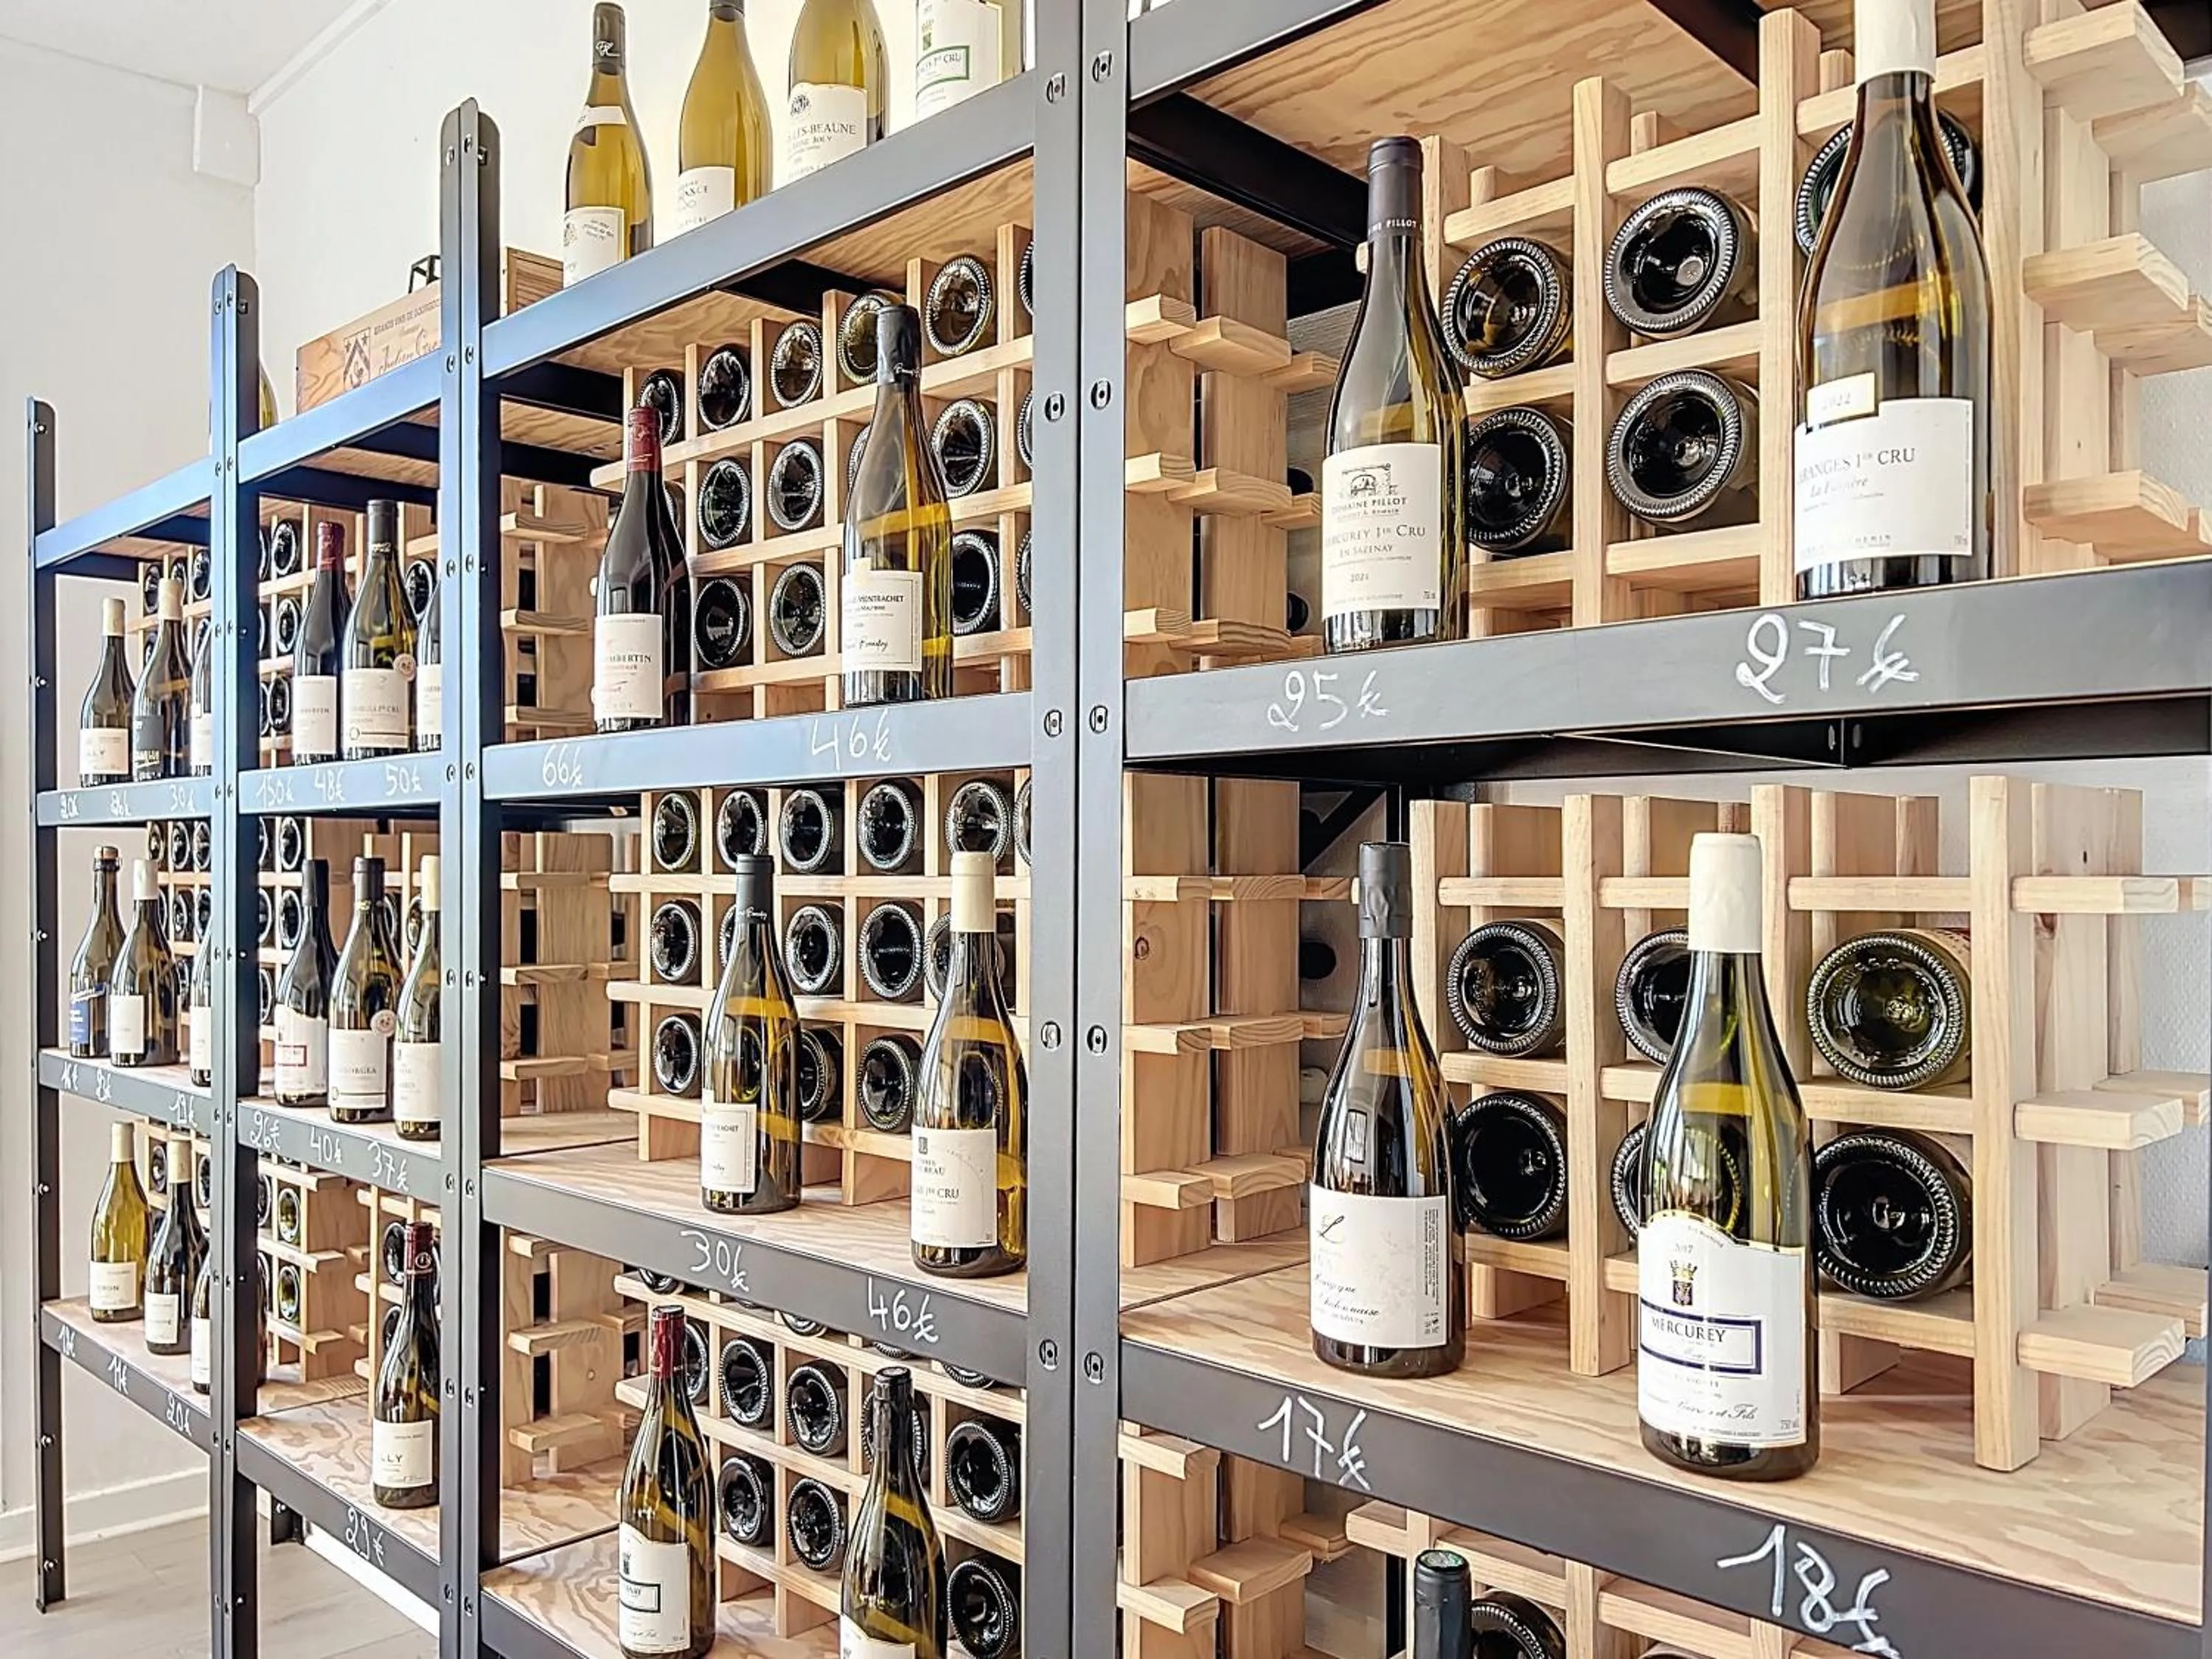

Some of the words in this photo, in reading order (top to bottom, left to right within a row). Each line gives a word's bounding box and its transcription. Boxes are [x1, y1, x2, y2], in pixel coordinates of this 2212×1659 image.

[1386, 218, 1416, 229] PILLOT
[1877, 448, 1916, 466] CRU
[1371, 496, 1407, 507] PILLOT
[936, 1188, 959, 1199] CRU
[680, 1230, 751, 1293] 30€
[867, 1276, 940, 1343] 46€
[1652, 1316, 1727, 1343] MERCUREY
